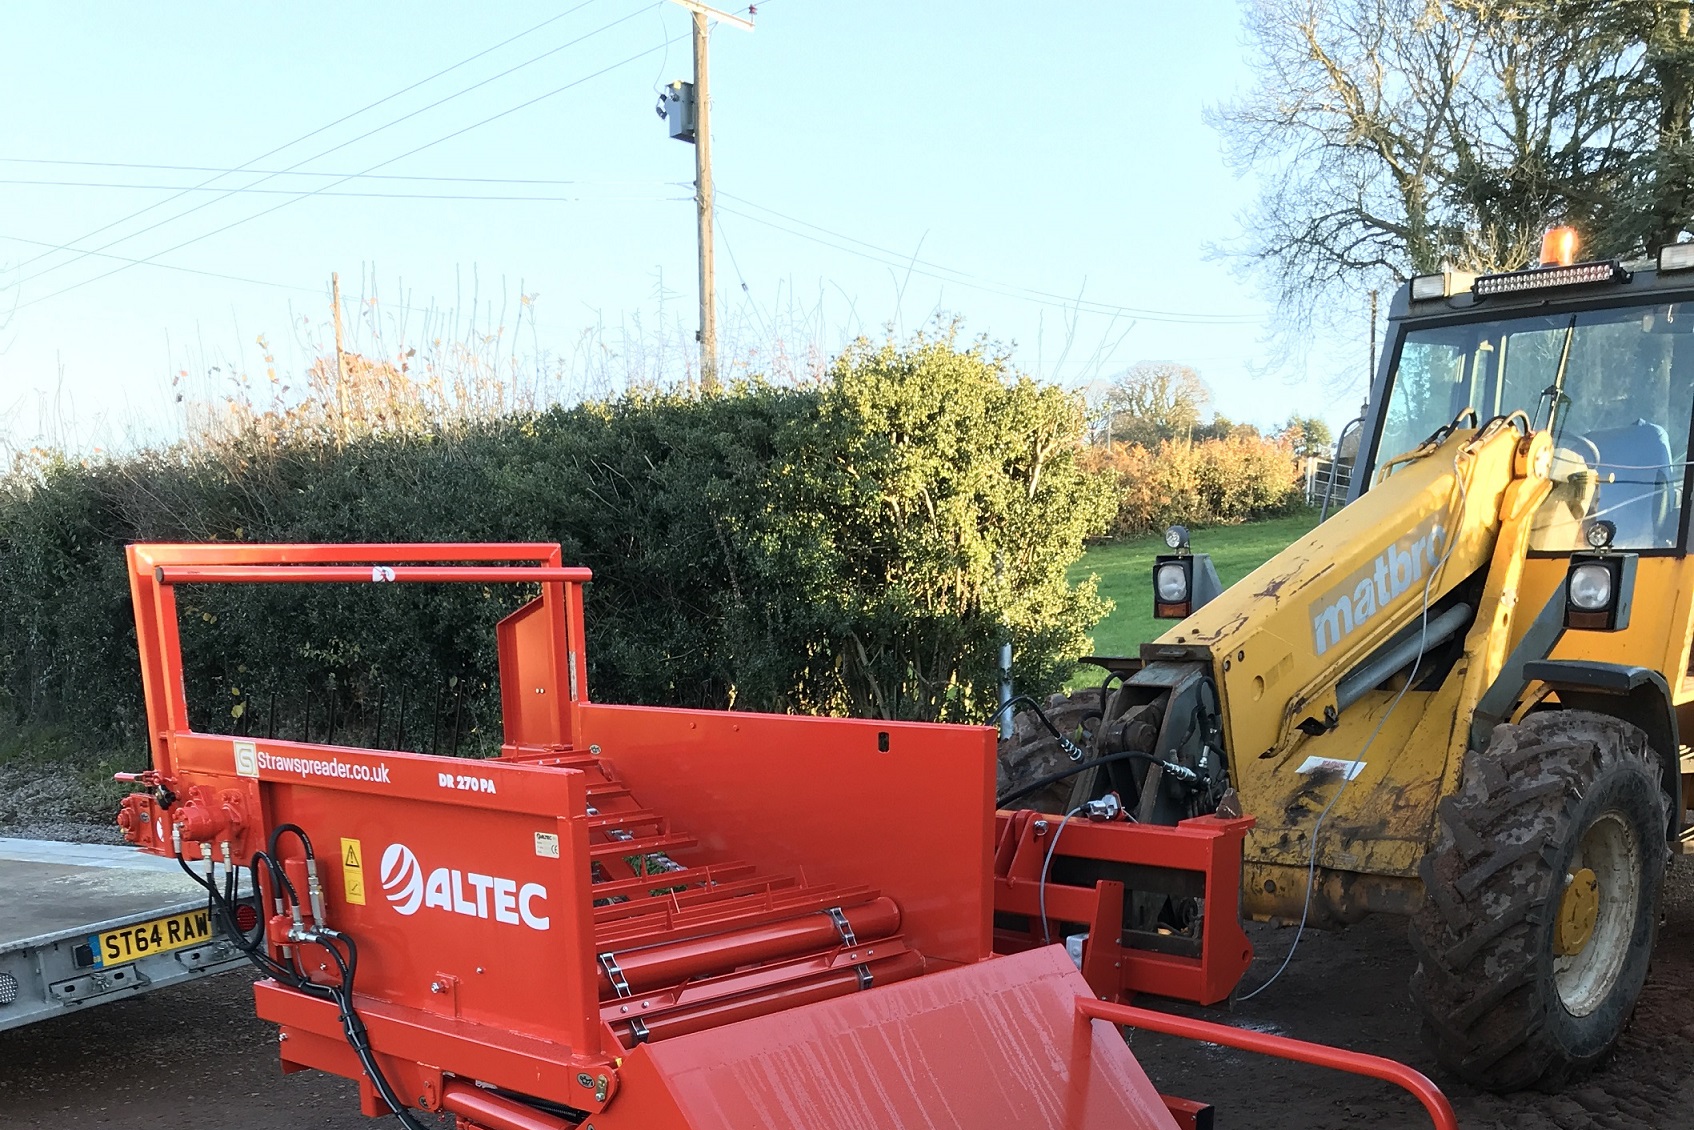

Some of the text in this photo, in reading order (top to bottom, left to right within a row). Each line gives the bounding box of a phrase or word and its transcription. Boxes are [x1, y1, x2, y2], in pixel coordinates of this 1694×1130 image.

[1313, 524, 1447, 657] matbro
[257, 751, 392, 784] Strawspreader.co.uk
[438, 772, 497, 794] DR 270 PA
[425, 867, 550, 931] ALTEC
[105, 912, 209, 959] ST64 RAW
